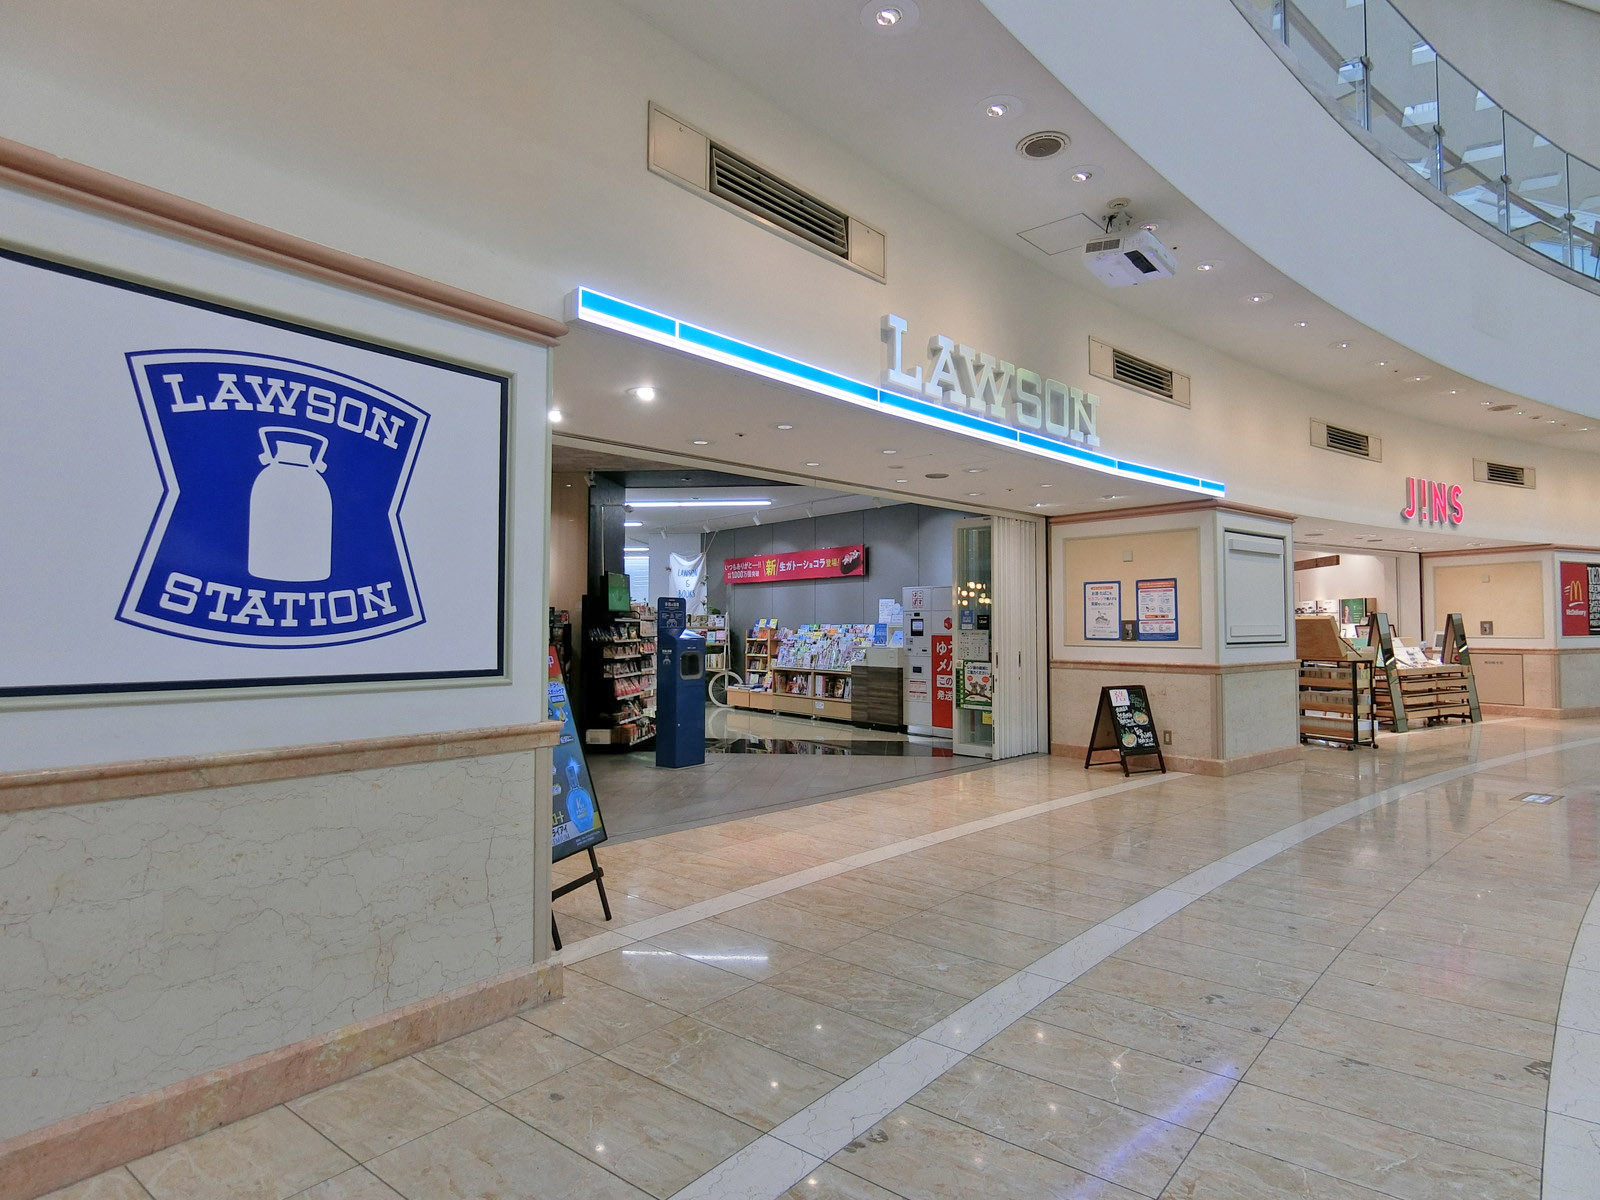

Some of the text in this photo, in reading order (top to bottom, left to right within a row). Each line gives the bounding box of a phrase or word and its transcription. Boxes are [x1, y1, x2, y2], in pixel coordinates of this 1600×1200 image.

[884, 313, 1101, 448] LAWSON
[162, 373, 406, 450] LAWSON
[677, 568, 699, 577] LAWSON
[765, 559, 777, 576] 新
[685, 579, 691, 588] &
[159, 571, 398, 627] STATION
[678, 589, 696, 598] BOOKS
